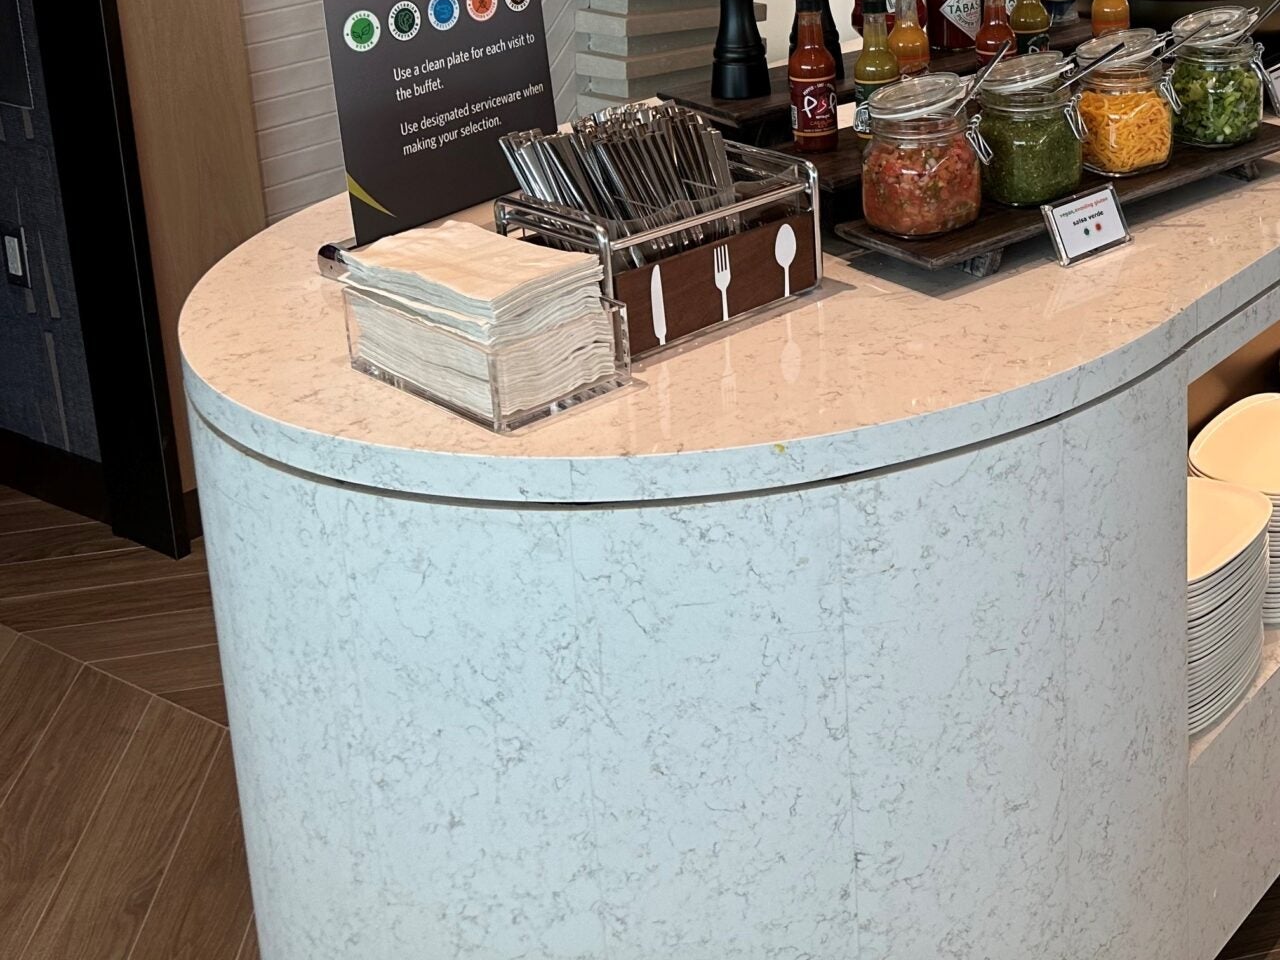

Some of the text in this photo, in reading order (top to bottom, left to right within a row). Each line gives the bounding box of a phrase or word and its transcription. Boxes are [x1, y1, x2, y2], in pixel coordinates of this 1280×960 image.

[948, 1, 980, 14] TABAS
[393, 33, 535, 81] Use a clean plate for each visit to
[396, 77, 444, 102] the buffet.
[400, 82, 544, 136] Use designated serviceware when
[403, 116, 502, 156] making your selection.
[1072, 210, 1104, 227] salsa verde
